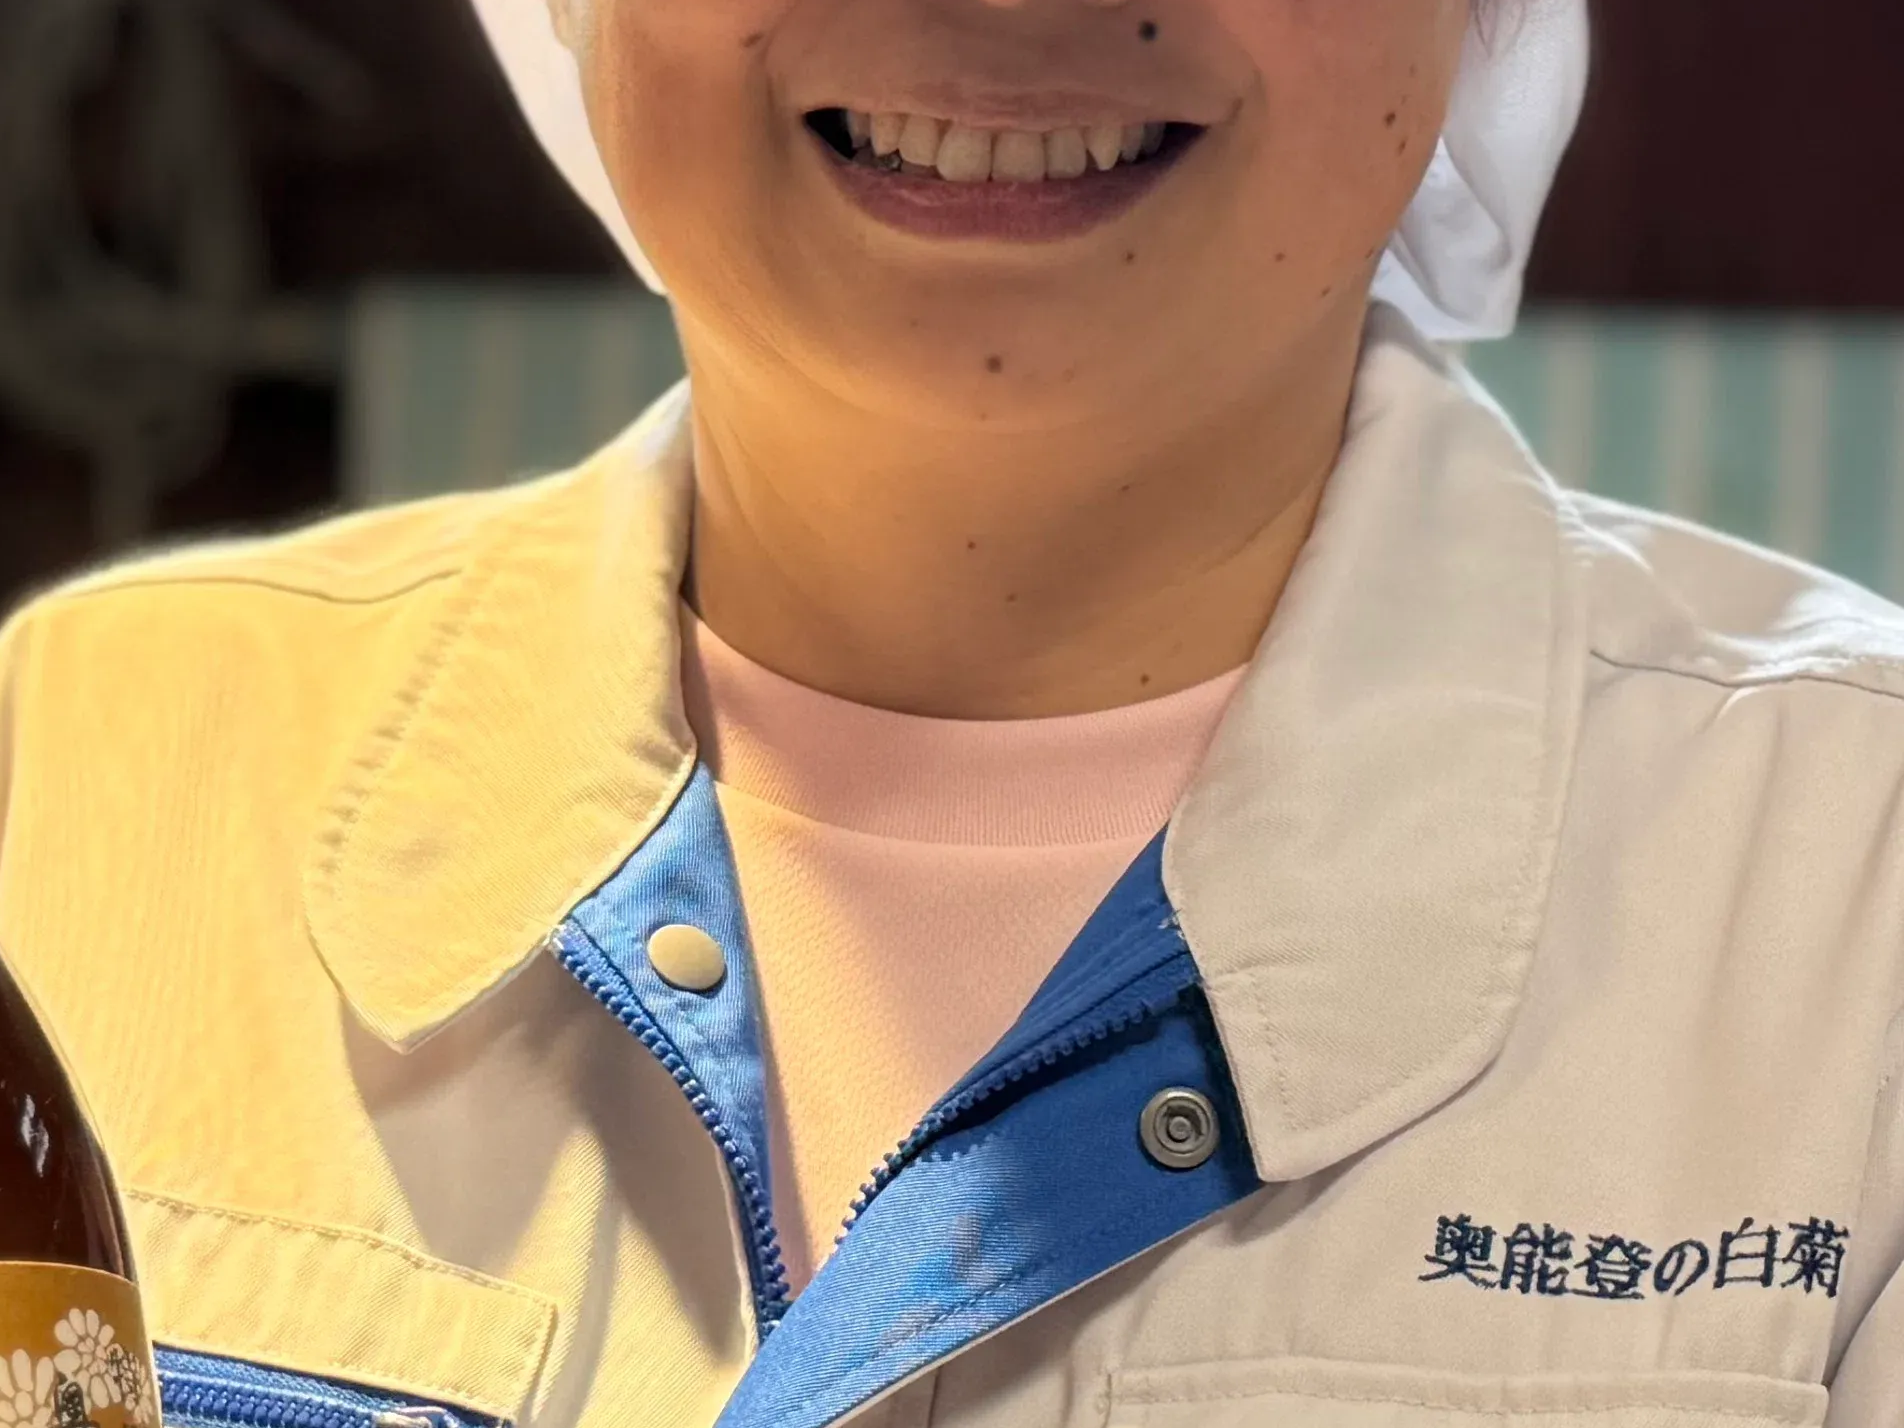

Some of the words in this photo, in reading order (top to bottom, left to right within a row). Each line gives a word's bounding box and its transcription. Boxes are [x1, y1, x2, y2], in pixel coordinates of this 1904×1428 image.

[1418, 1213, 1851, 1300] 奥能登の白菊
